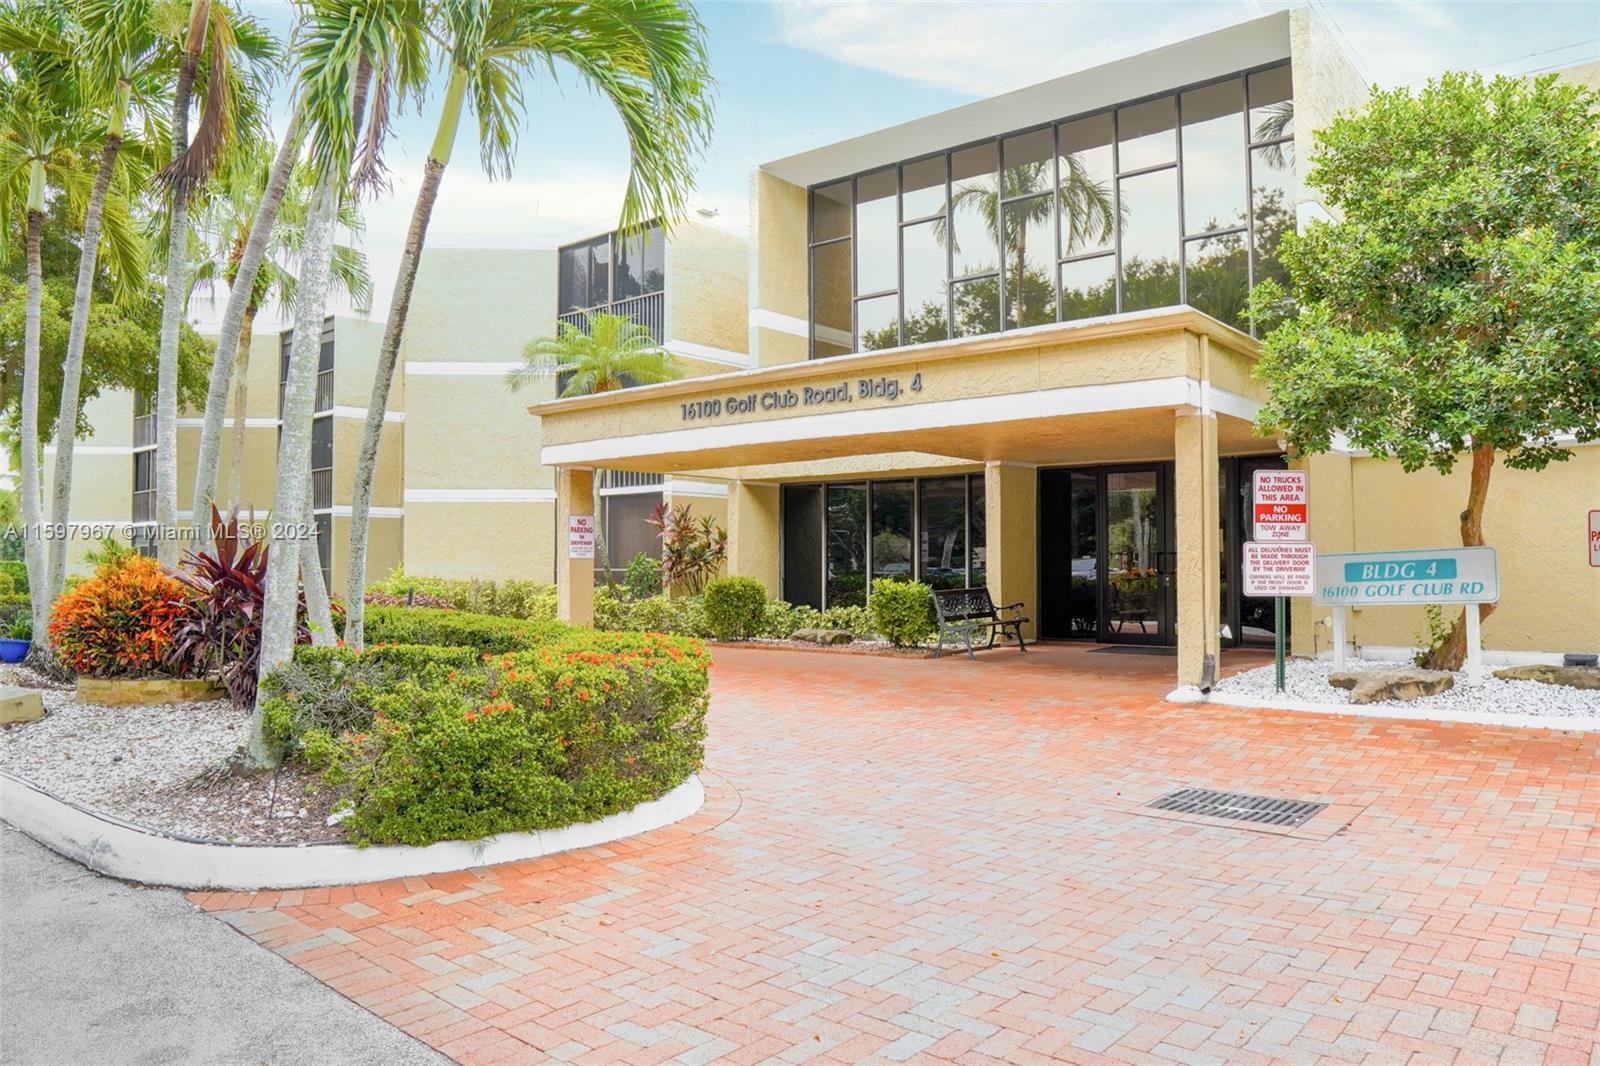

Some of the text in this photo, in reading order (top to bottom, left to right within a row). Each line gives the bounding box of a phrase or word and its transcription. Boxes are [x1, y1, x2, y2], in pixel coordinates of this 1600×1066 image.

[681, 373, 923, 420] 16100 Golf Club Road, Bldg. 4
[1260, 476, 1301, 484] NO TRUCKS
[1273, 505, 1288, 513] NO
[1260, 513, 1302, 522] PARKING
[1362, 561, 1437, 580] BLDG 4
[1322, 581, 1484, 599] 16100 GOLF CLUB RD
